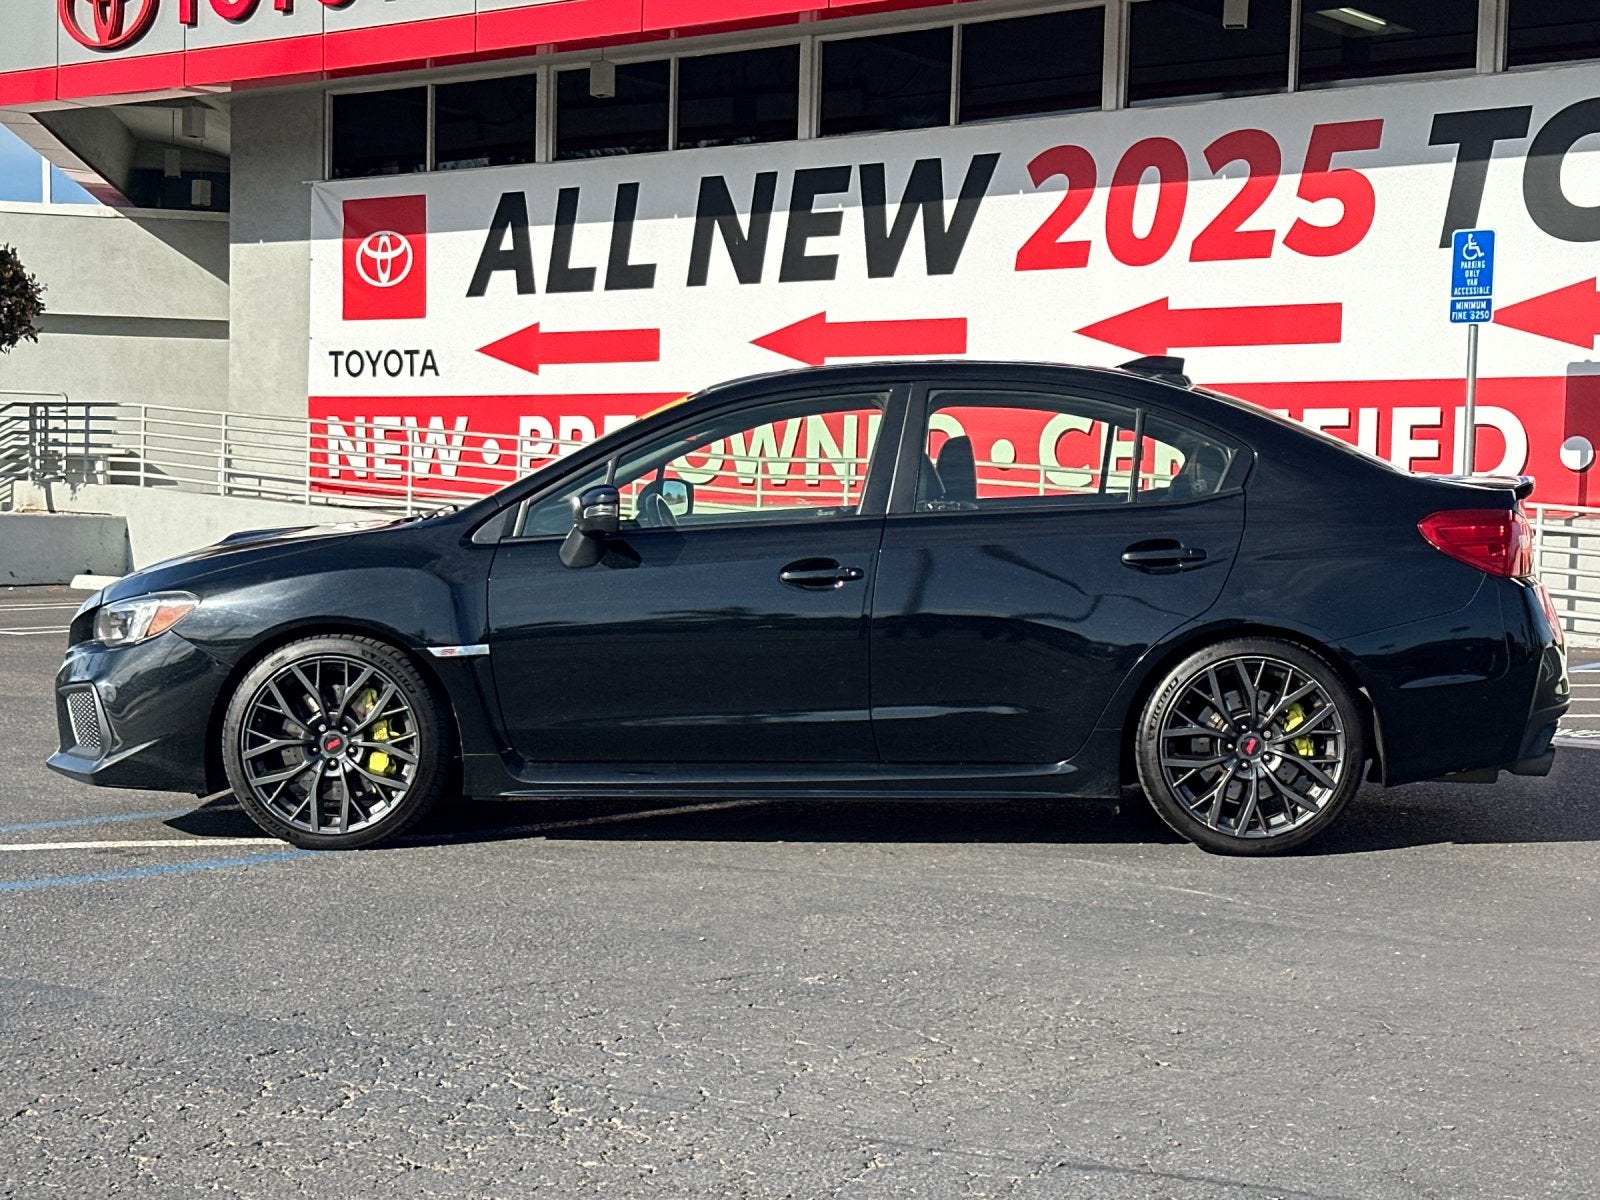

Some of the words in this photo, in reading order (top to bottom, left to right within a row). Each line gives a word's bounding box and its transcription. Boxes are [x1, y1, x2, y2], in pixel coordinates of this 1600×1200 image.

[466, 181, 657, 298] ALL
[687, 153, 1002, 287] NEW
[1014, 119, 1382, 272] 2025
[1460, 260, 1486, 270] PARKING
[1464, 269, 1481, 278] ONLY
[1466, 278, 1478, 287] VAN
[1453, 286, 1490, 295] ACCESSIBLE
[1456, 301, 1487, 310] MINIMUM
[1451, 311, 1467, 320] FINE
[1469, 310, 1490, 320] $250
[328, 349, 440, 378] TOYOTA
[326, 415, 469, 479] NEW
